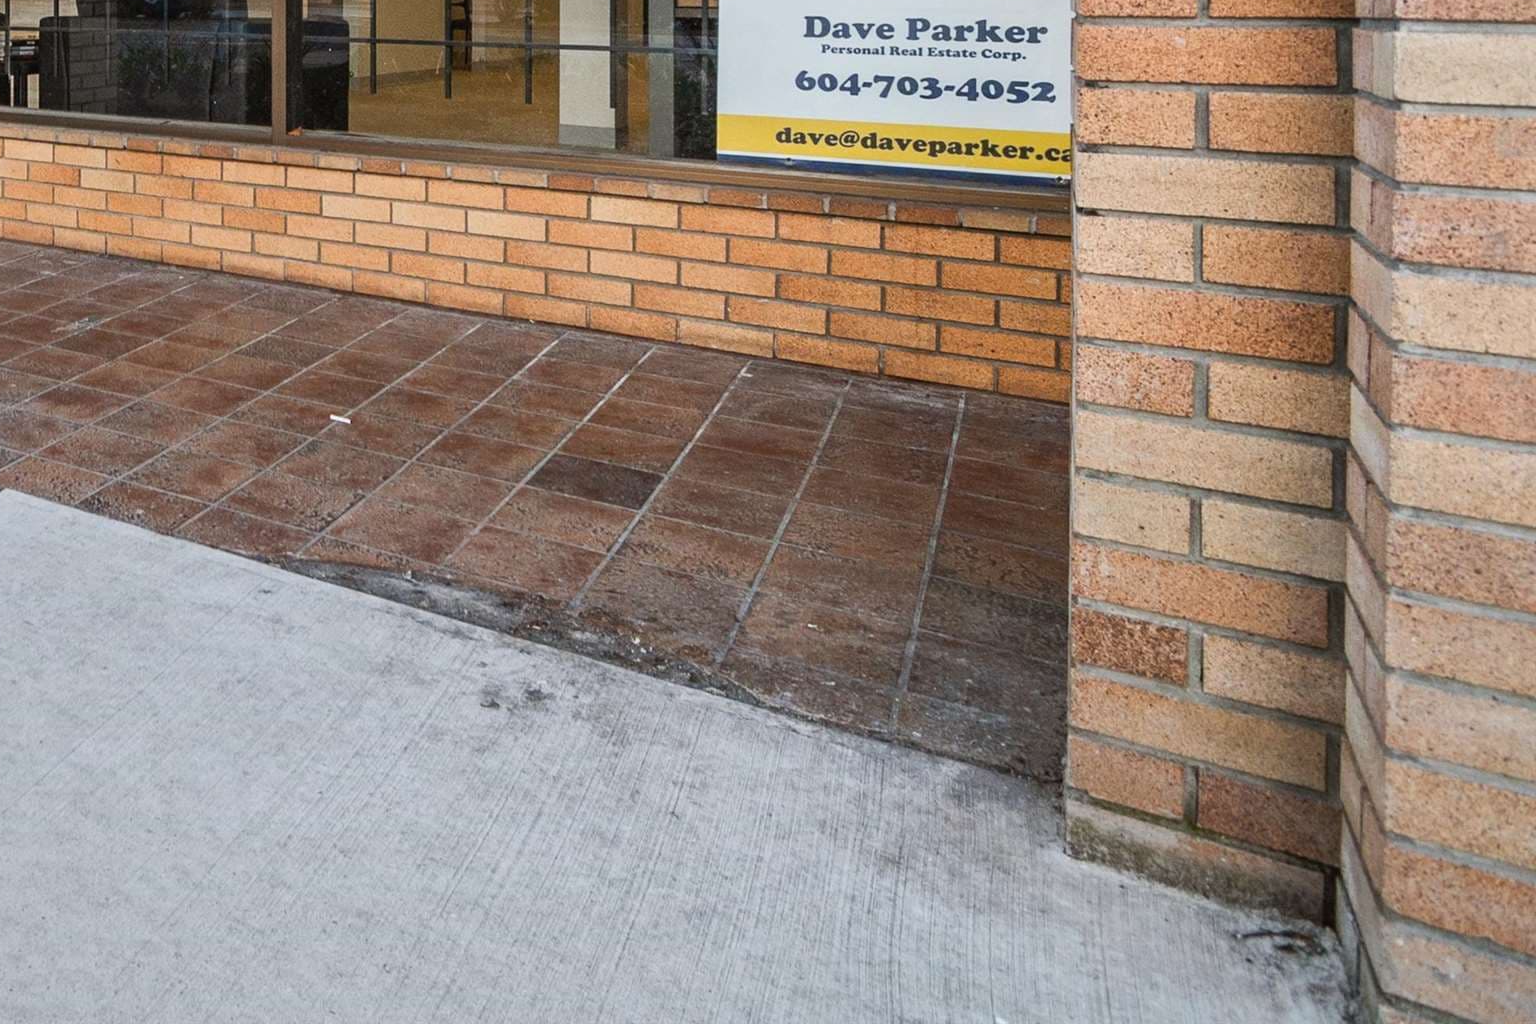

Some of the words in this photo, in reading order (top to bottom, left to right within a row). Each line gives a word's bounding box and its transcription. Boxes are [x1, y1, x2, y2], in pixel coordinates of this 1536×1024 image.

[803, 15, 895, 41] Dave
[906, 17, 1049, 44] Parker
[821, 43, 885, 56] Personal
[889, 45, 923, 57] Real
[927, 47, 977, 59] Estate
[980, 48, 1027, 62] Corp.
[794, 69, 1057, 104] 604-703-4052
